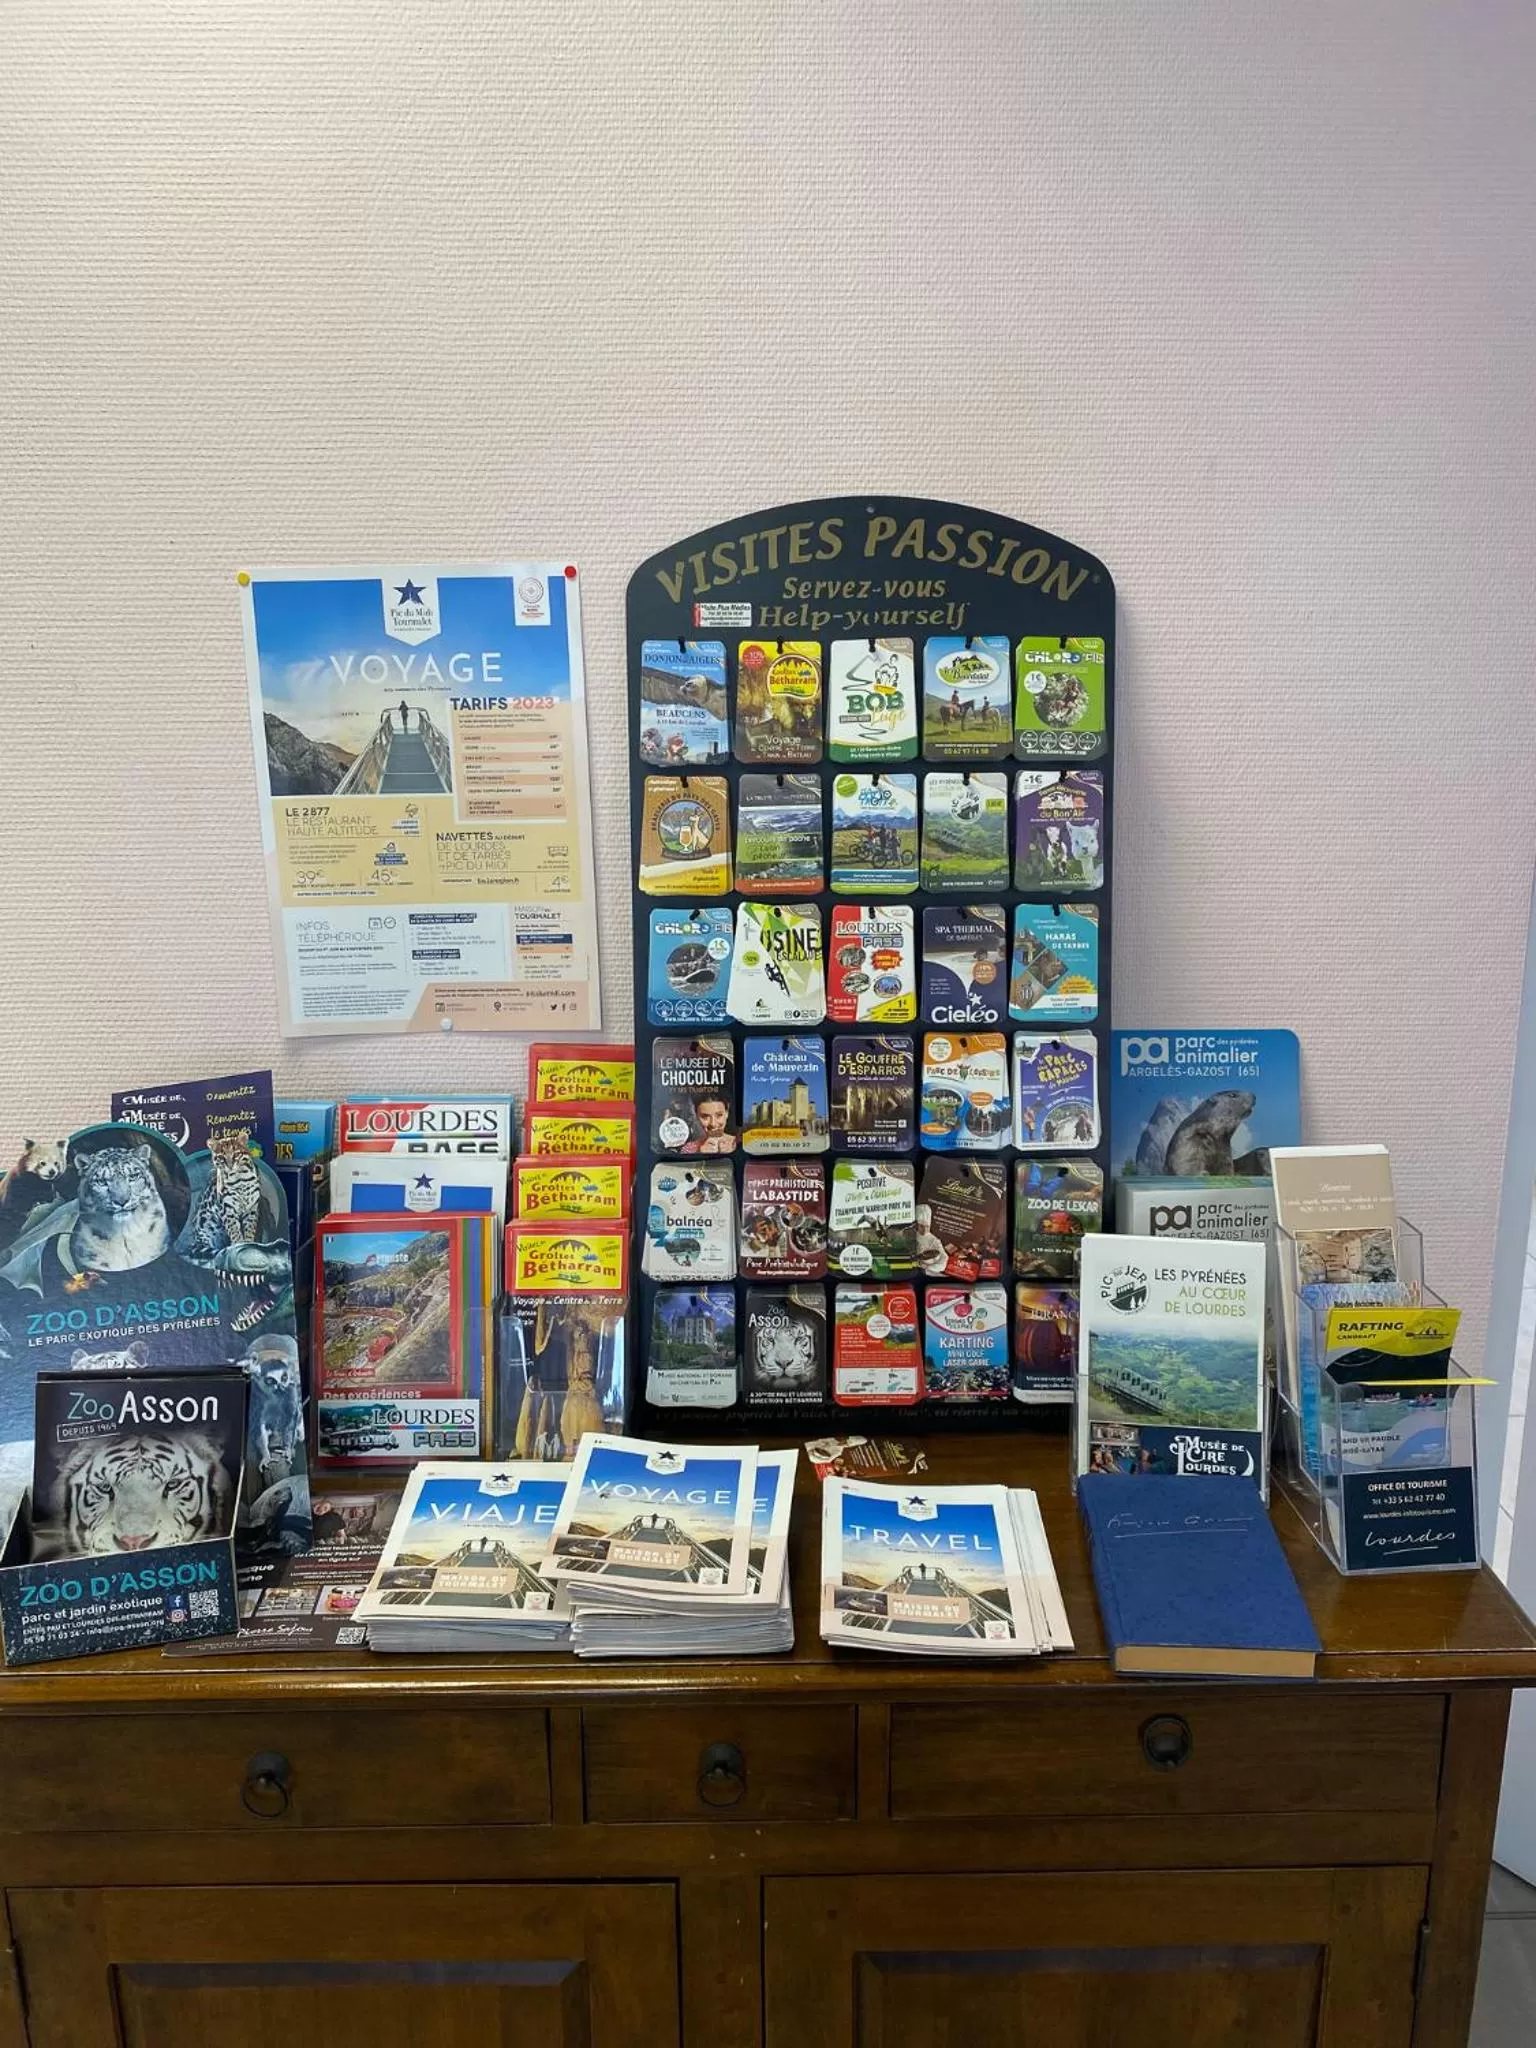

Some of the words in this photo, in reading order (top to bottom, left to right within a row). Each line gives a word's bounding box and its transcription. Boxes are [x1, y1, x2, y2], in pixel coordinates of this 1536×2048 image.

[656, 518, 844, 602] VISITES
[864, 516, 1088, 601] PASSION
[783, 576, 946, 600] Servez-vous
[757, 602, 966, 632] Help-yourself
[329, 652, 503, 686] VOYAGE
[450, 698, 508, 711] TARIFS
[512, 697, 554, 709] 2023
[847, 691, 904, 714] BOB
[286, 808, 299, 817] LE
[303, 807, 330, 816] 2877
[436, 832, 493, 841] NAVETTES
[837, 922, 903, 934] LOURDES
[862, 937, 903, 948] PASS
[932, 1005, 998, 1023] Cieléo
[1175, 1037, 1215, 1049] parc
[839, 1054, 851, 1063] LE
[1175, 1048, 1258, 1063] animalier
[769, 1063, 819, 1072] Mauvezin
[662, 1070, 726, 1086] CHOCOLAT
[206, 1112, 256, 1126] Remontez
[348, 1110, 497, 1132] LOURDES
[753, 1190, 819, 1201] LABASTIDE
[1028, 1199, 1050, 1210] ZOO
[1199, 1204, 1232, 1216] parc
[667, 1216, 712, 1227] balnéa
[1197, 1213, 1268, 1229] animalier
[1125, 1265, 1147, 1284] JER
[1154, 1268, 1176, 1280] LES
[1182, 1268, 1246, 1284] PYRÉNÉES
[1179, 1287, 1197, 1298] AU
[513, 1297, 544, 1306] Voyage
[554, 1296, 584, 1304] Centre
[599, 1296, 622, 1304] Terre
[26, 1312, 88, 1336] ZOO
[96, 1294, 220, 1326] D'ASSON
[1165, 1302, 1181, 1313] DE
[1186, 1302, 1246, 1316] LOURDES
[749, 1313, 790, 1328] Asson
[1338, 1322, 1404, 1331] RAFTING
[28, 1338, 42, 1347] LE
[46, 1334, 76, 1344] PARC
[78, 1327, 135, 1341] EXOTIQUE
[138, 1324, 159, 1334] DES
[162, 1316, 220, 1331] PYRÉNÉES
[940, 1337, 994, 1348] KARTING
[68, 1392, 114, 1420] Zoo
[118, 1390, 218, 1424] Asson
[373, 1409, 475, 1425] LOURDES
[62, 1424, 96, 1436] DEPUIS
[413, 1431, 476, 1447] PASS
[591, 1479, 732, 1505] VOYAGE
[1368, 1483, 1394, 1492] OFFICE
[1407, 1480, 1447, 1489] TOURISME
[430, 1503, 560, 1525] VIAJE
[849, 1524, 993, 1550] TRAVEL
[19, 1580, 82, 1606] ZOO
[90, 1561, 217, 1597] D'ASSON
[22, 1613, 51, 1625] parc
[54, 1610, 66, 1618] et
[68, 1604, 106, 1619] jardin
[110, 1596, 162, 1612] exotique
